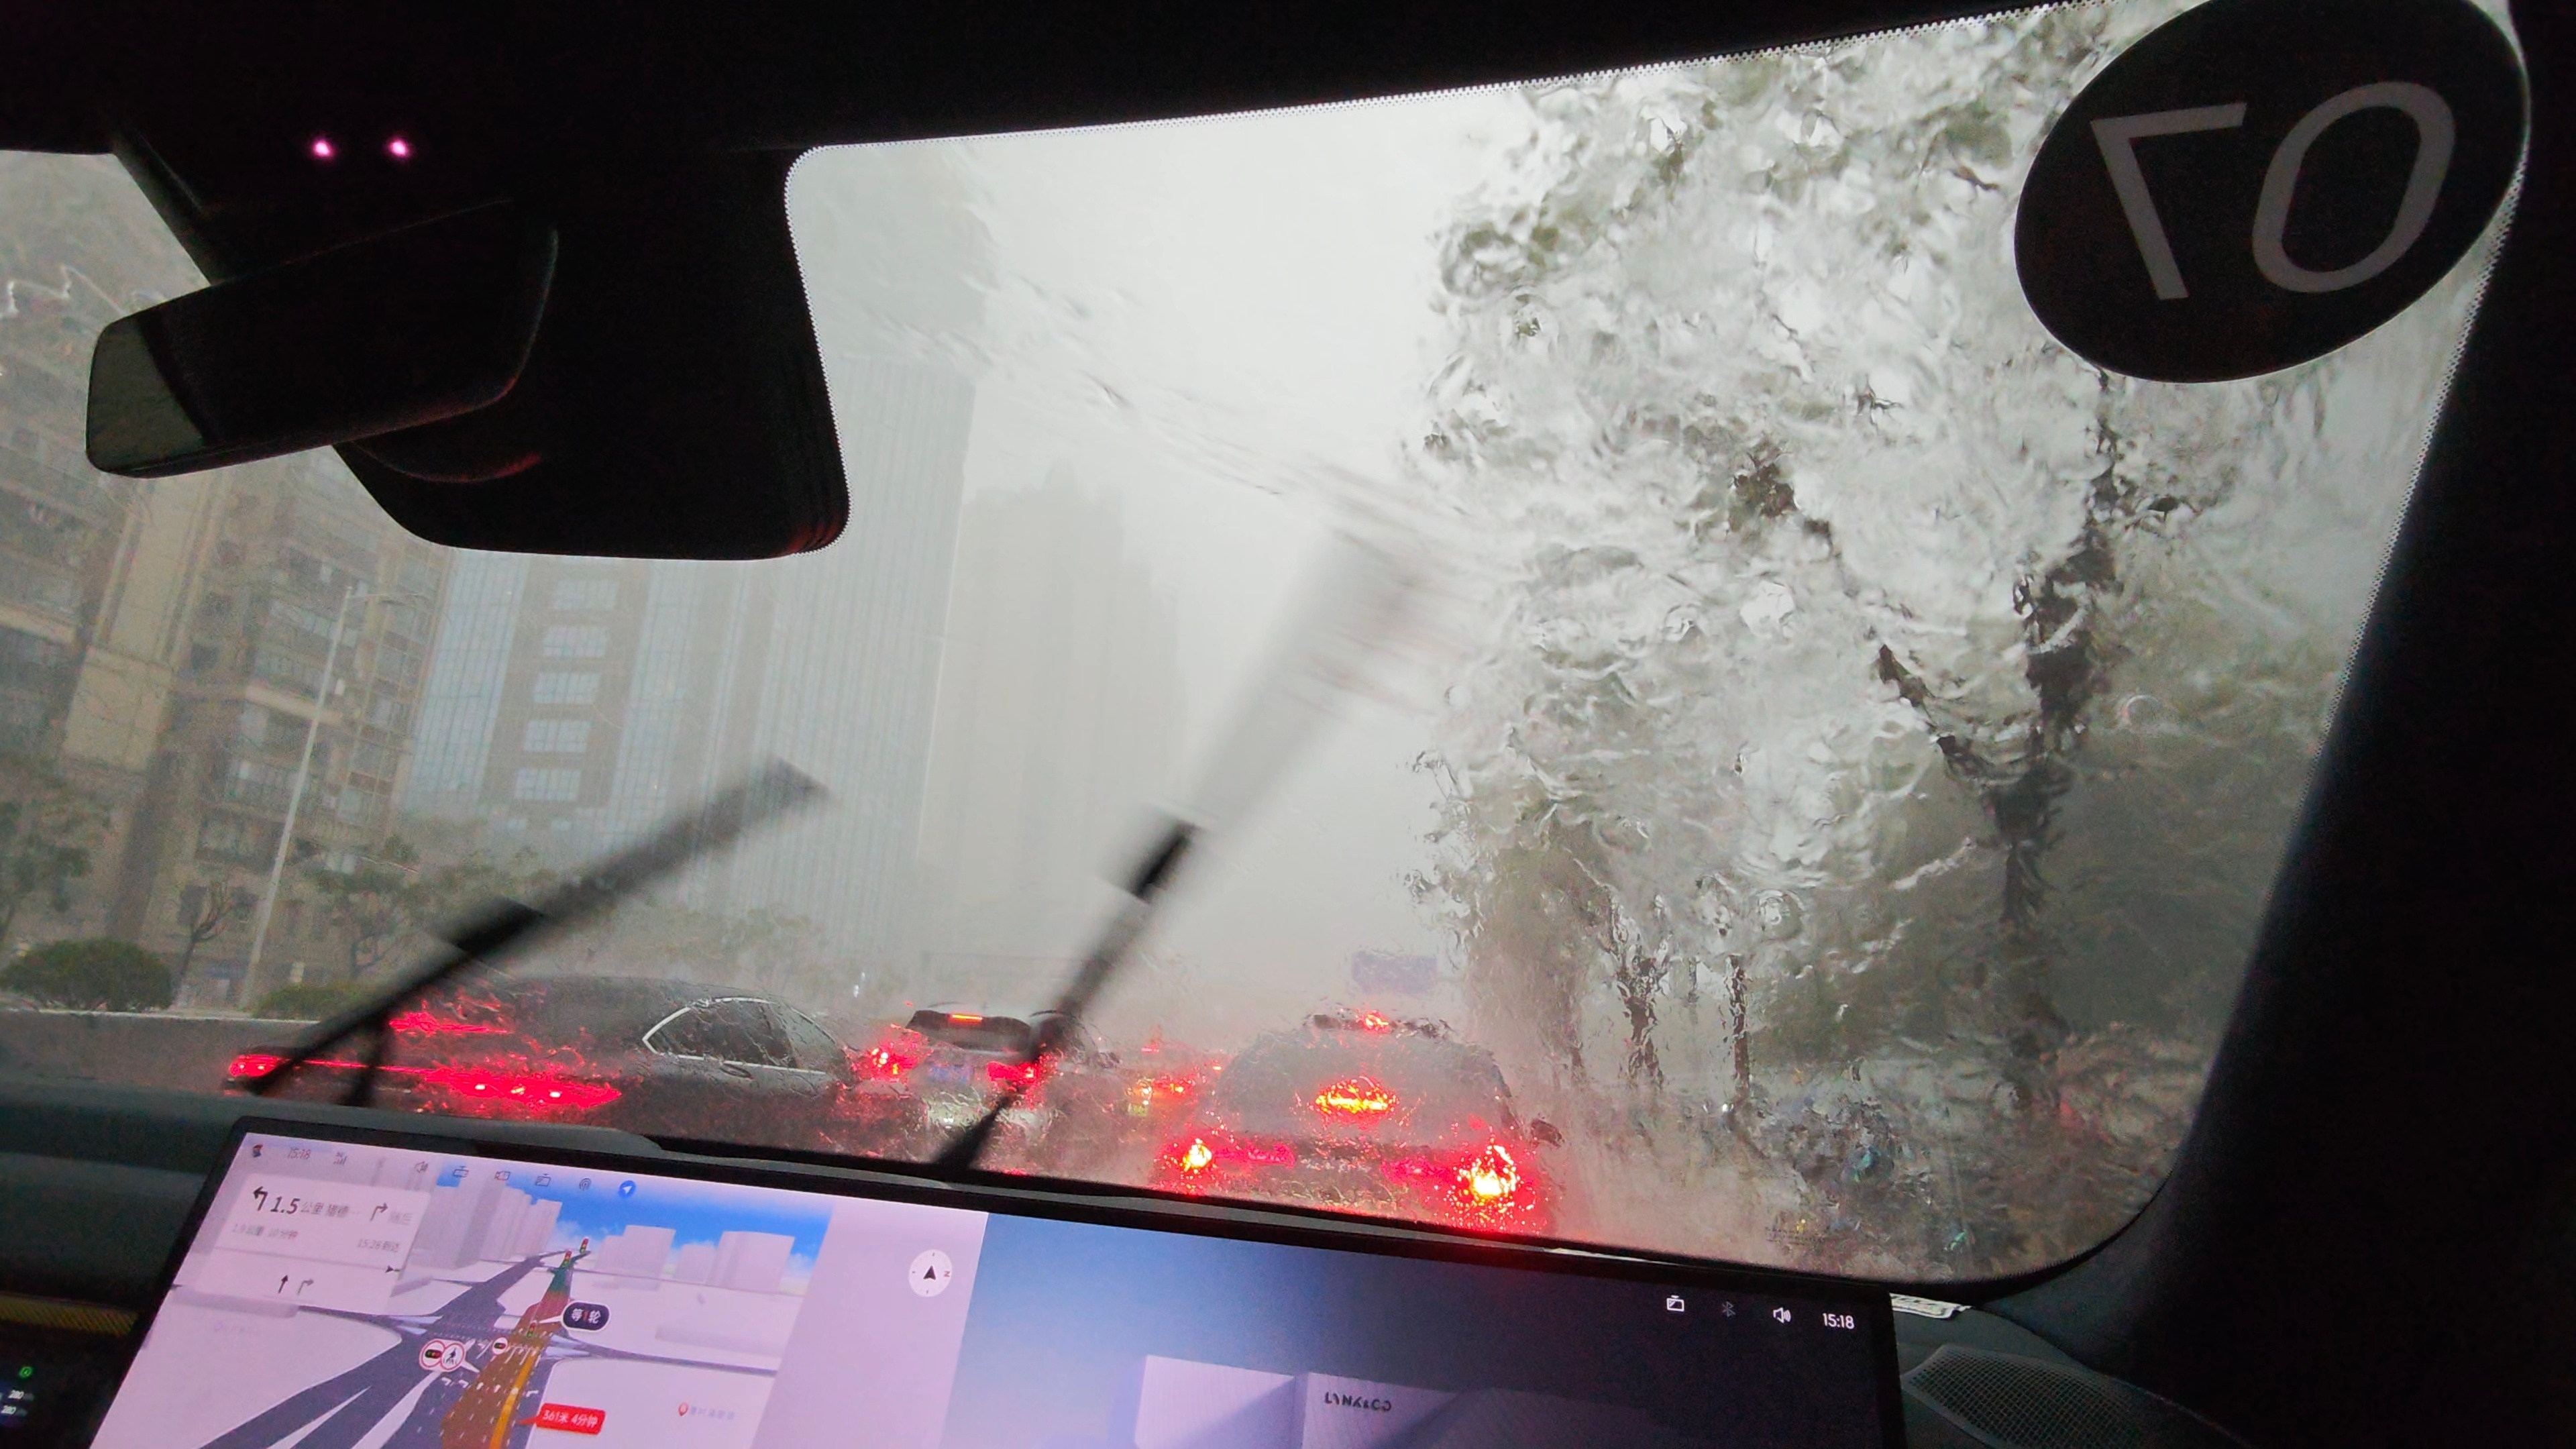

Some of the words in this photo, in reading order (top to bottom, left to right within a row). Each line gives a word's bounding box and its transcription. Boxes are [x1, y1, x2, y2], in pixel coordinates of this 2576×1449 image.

[287, 1146, 311, 1159] 15:18
[270, 1196, 301, 1214] 1.5
[1823, 1313, 1854, 1329] 15:18
[542, 1409, 570, 1425] 361米
[571, 1413, 598, 1428] 4分钟
